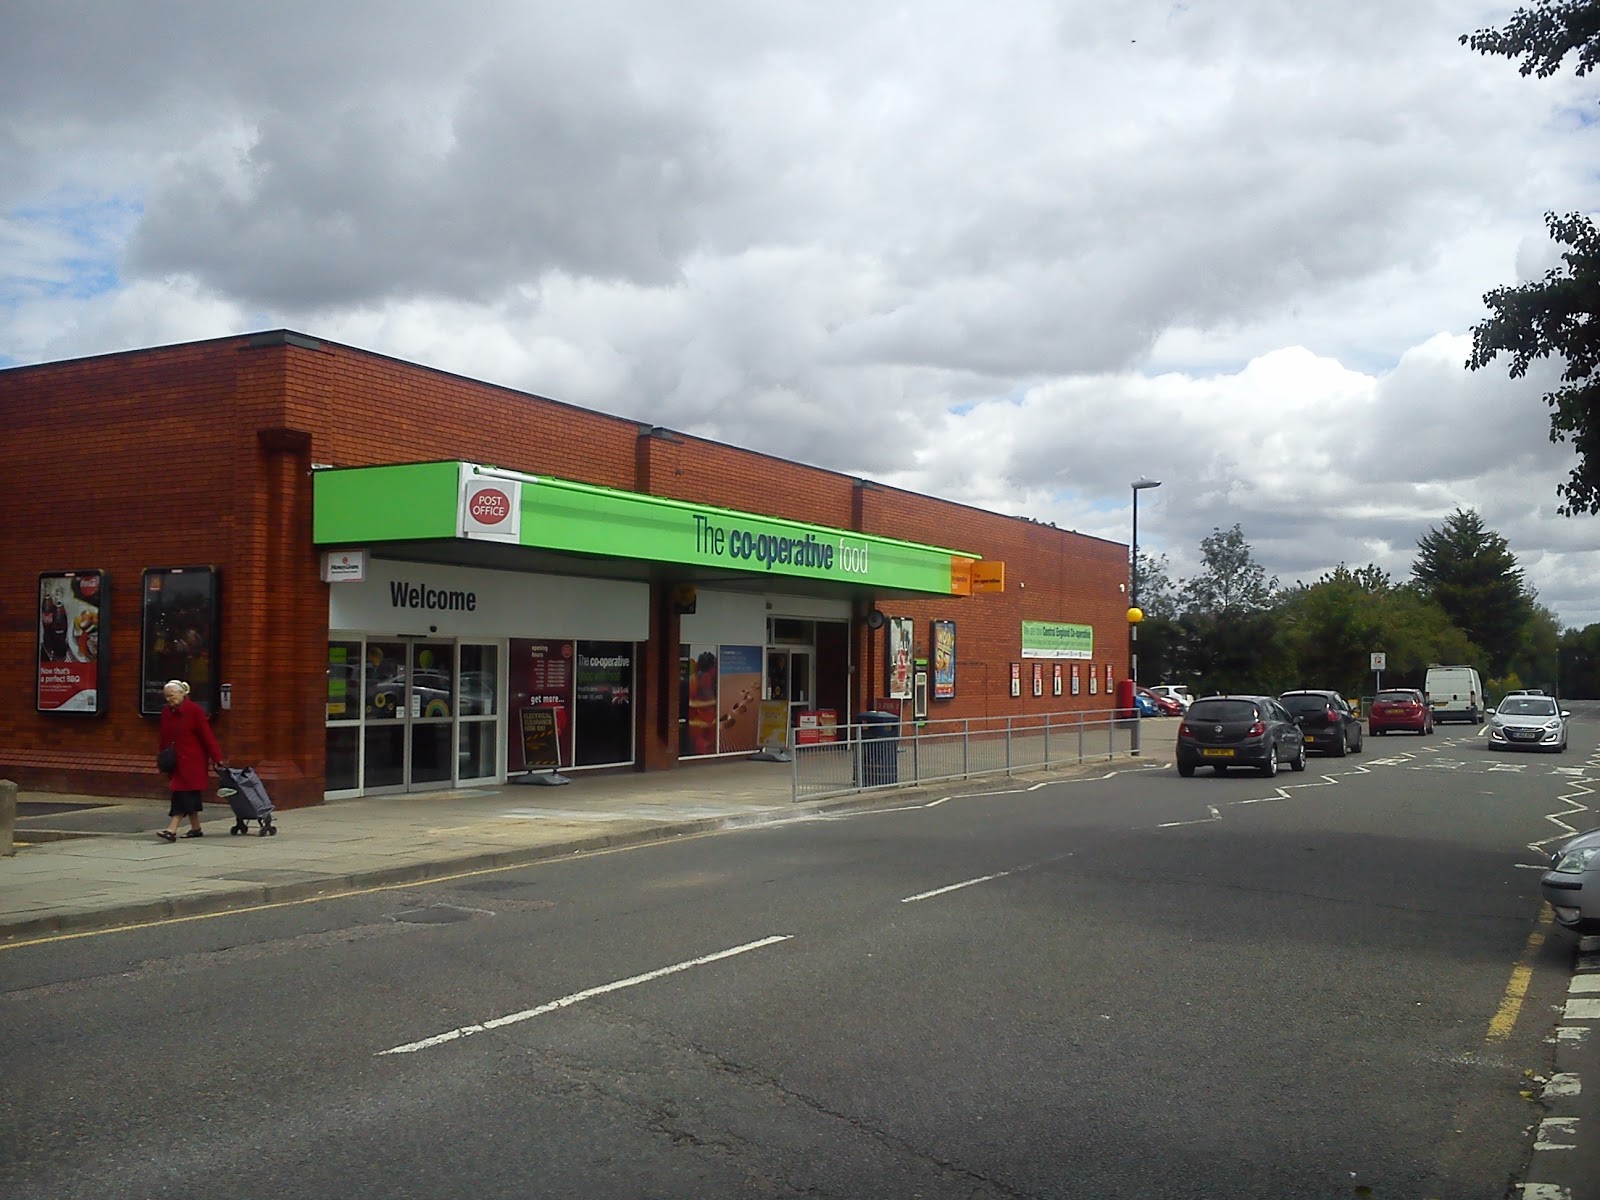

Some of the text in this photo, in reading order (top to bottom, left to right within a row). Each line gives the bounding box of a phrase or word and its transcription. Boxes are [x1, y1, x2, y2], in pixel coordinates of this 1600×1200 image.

[478, 495, 503, 506] POST
[472, 505, 505, 517] OFFICE
[692, 514, 868, 574] The co-operative food
[389, 580, 477, 612] Welcome
[531, 645, 549, 653] opening
[578, 654, 630, 669] The co-operative
[40, 667, 53, 675] Now
[45, 675, 66, 684] perfect
[66, 675, 81, 683] BBQ
[530, 695, 565, 706] get more...
